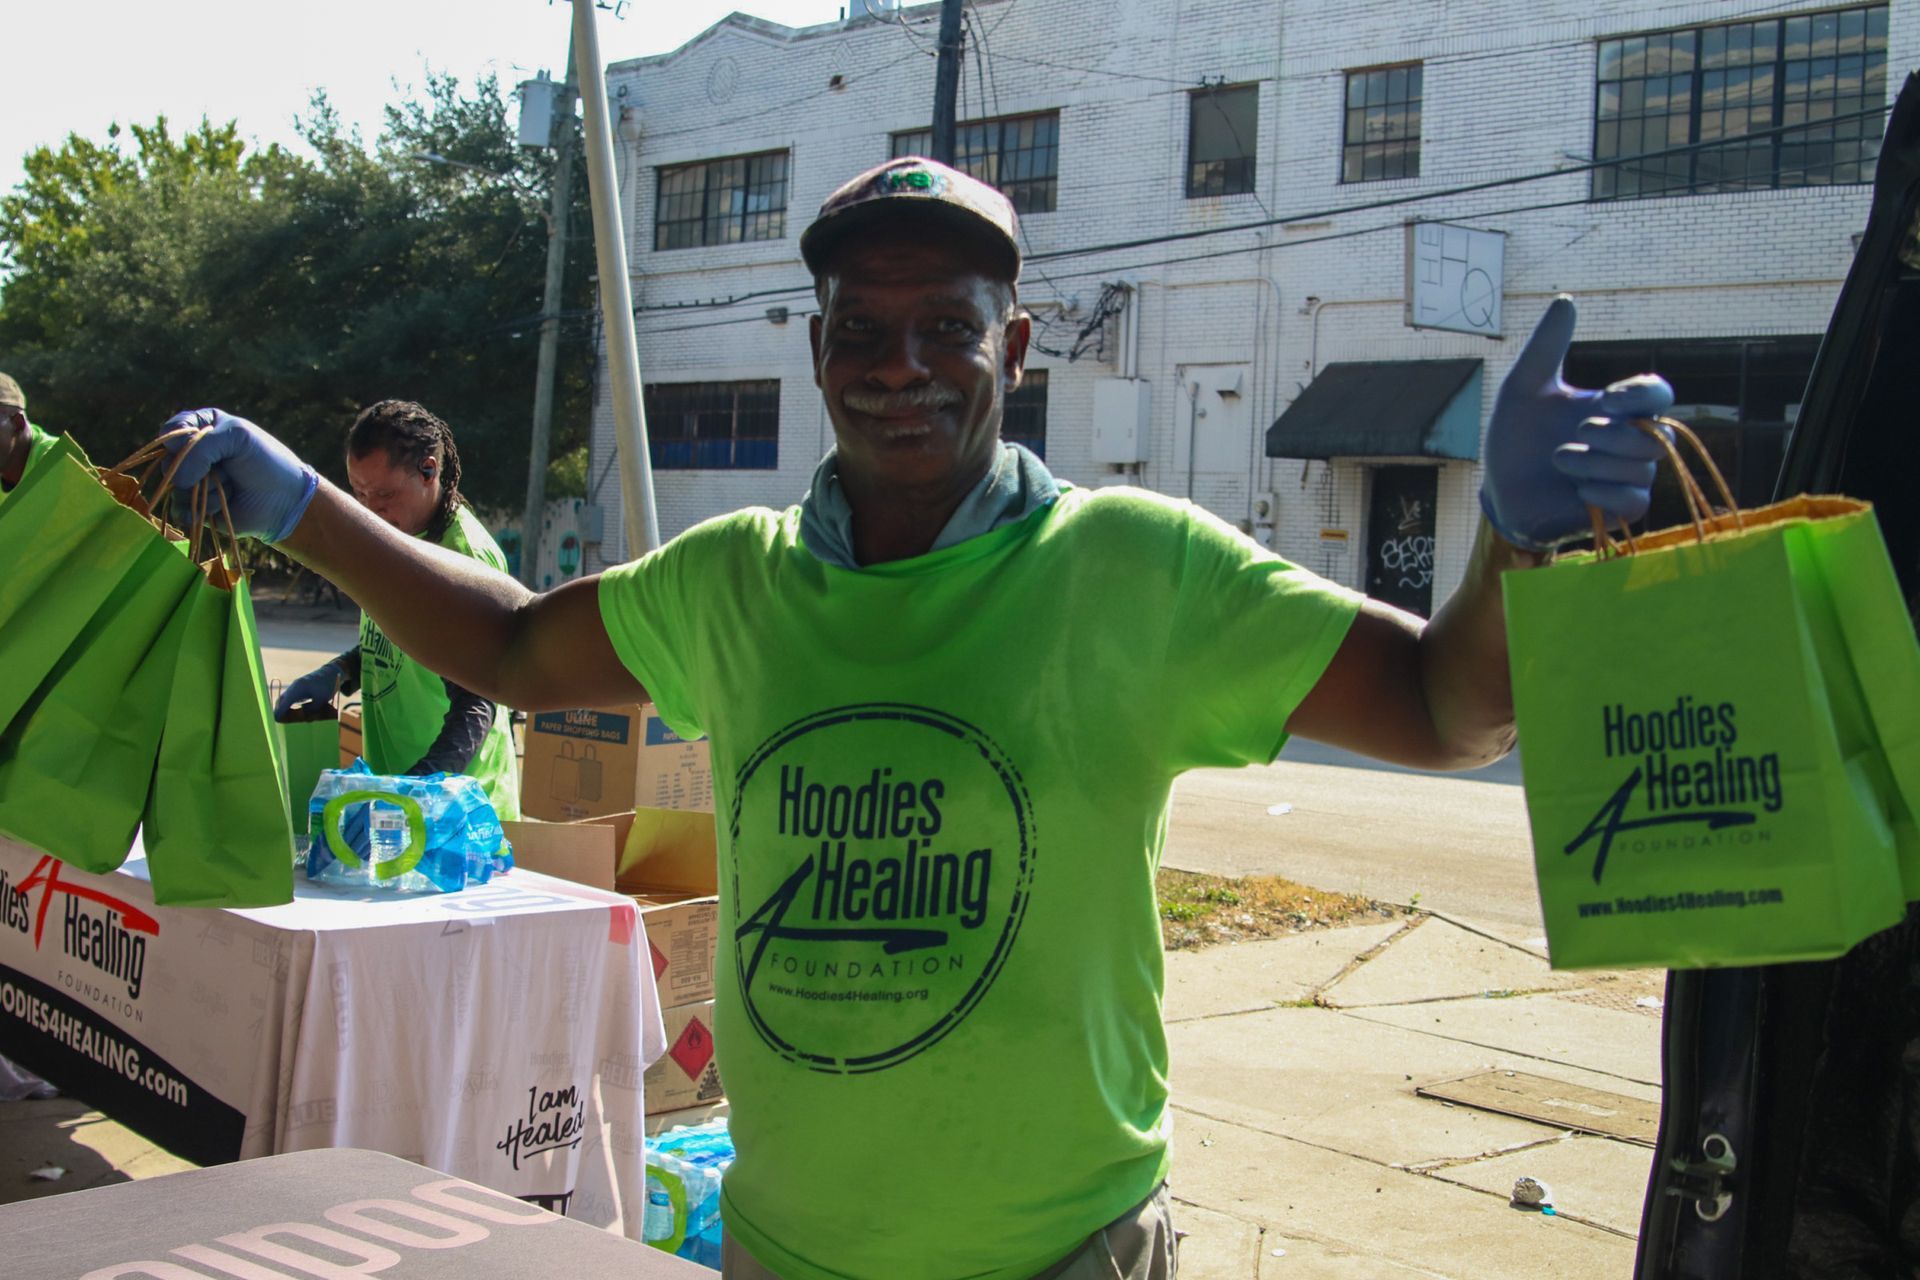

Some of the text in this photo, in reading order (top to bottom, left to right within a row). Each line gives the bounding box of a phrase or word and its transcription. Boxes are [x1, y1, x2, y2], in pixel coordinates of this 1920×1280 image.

[1440, 226, 1496, 330] HQ
[541, 721, 563, 732] PAPER
[601, 730, 621, 741] BAGS
[565, 711, 599, 727] ULINE
[1603, 695, 1738, 758] Hoodies
[778, 764, 945, 840] Hoodies
[1646, 746, 1784, 813] Healing
[1620, 829, 1772, 853] FOUNDATION
[812, 838, 993, 930] Healing
[1578, 888, 1785, 918] www.Hoodies4Healing.com
[63, 893, 146, 1000] Healing
[770, 953, 964, 979] FOUNDATION
[57, 970, 143, 1023] FOUNDATION
[768, 982, 929, 1003] www.Hoodies4Healing.org
[0, 982, 188, 1107] ODIES4HEALING.com
[539, 1085, 579, 1113] am
[497, 1101, 585, 1171] Healed
